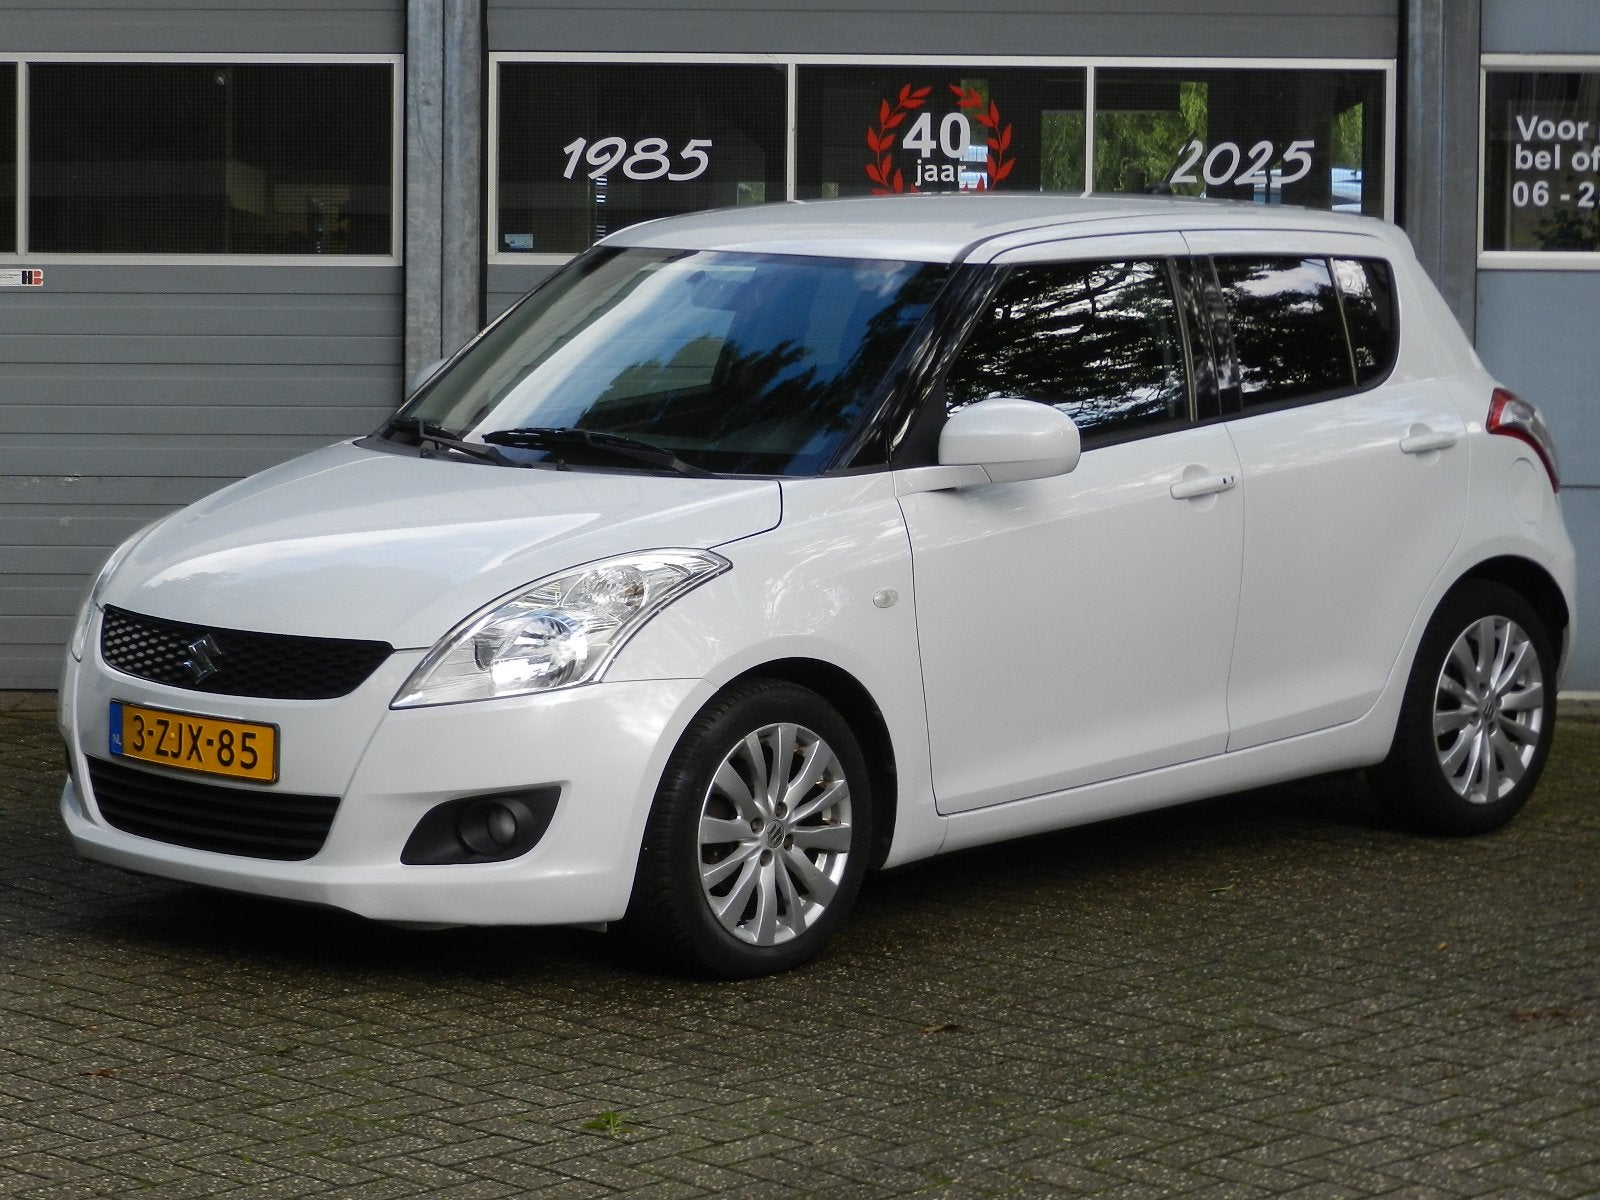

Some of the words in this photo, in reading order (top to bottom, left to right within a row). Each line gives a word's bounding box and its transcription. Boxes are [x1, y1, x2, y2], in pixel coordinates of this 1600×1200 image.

[902, 112, 971, 159] 40
[1515, 115, 1589, 142] Voor
[563, 136, 713, 182] 1985
[914, 159, 967, 187] jaar
[1169, 139, 1315, 186] 2025
[1515, 143, 1561, 171] bel
[1571, 145, 1600, 172] of
[1512, 180, 1549, 207] 06
[1577, 181, 1600, 208] 2
[132, 714, 259, 770] 3-ZJX-85
